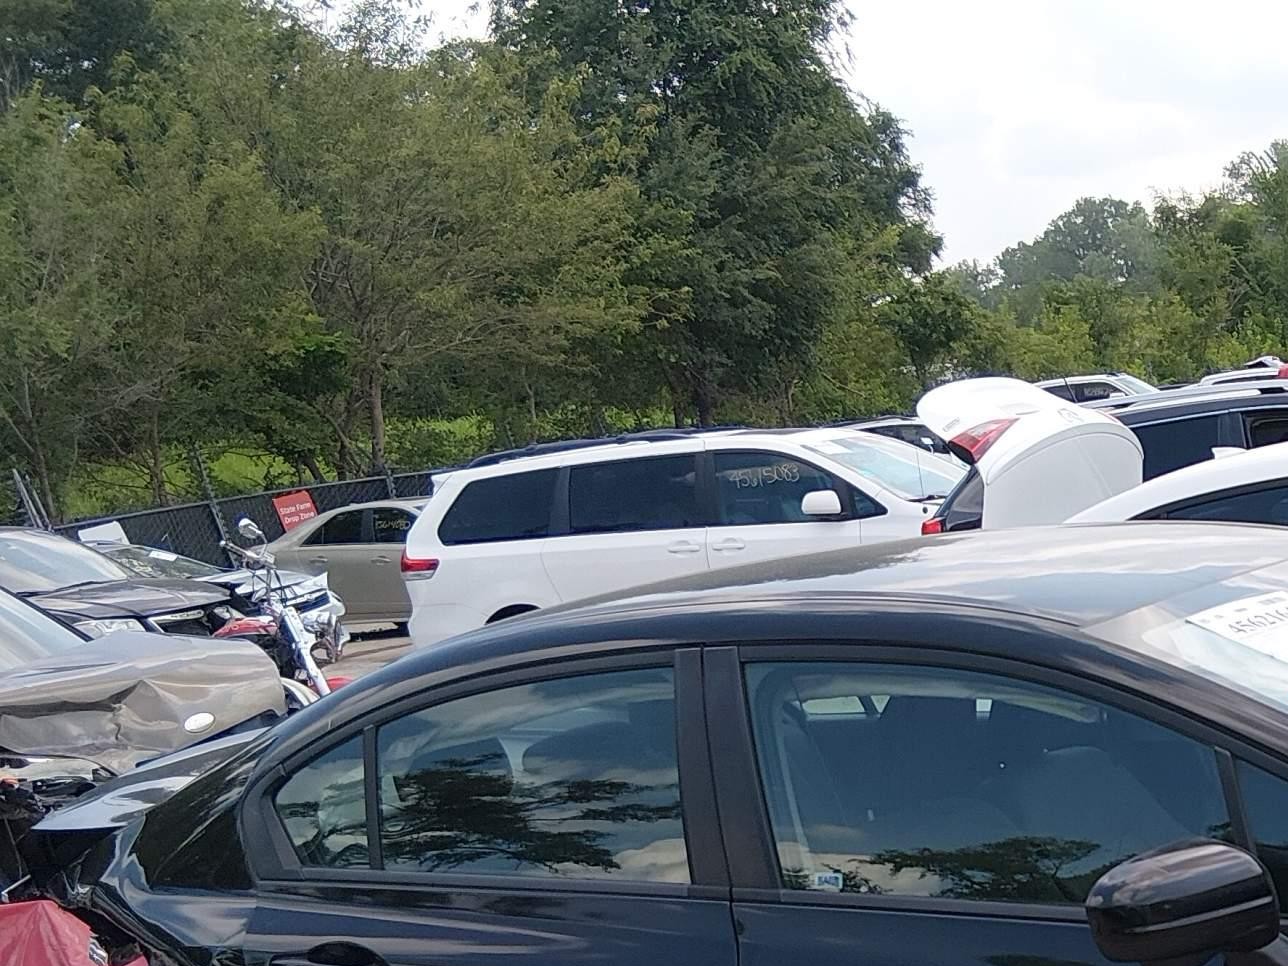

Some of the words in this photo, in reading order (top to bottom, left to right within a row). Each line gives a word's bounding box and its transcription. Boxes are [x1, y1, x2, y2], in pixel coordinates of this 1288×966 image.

[728, 462, 800, 489] 45615083
[279, 503, 296, 515] State
[295, 501, 311, 512] Farm
[284, 513, 300, 525] Drop
[299, 510, 315, 521] Zone
